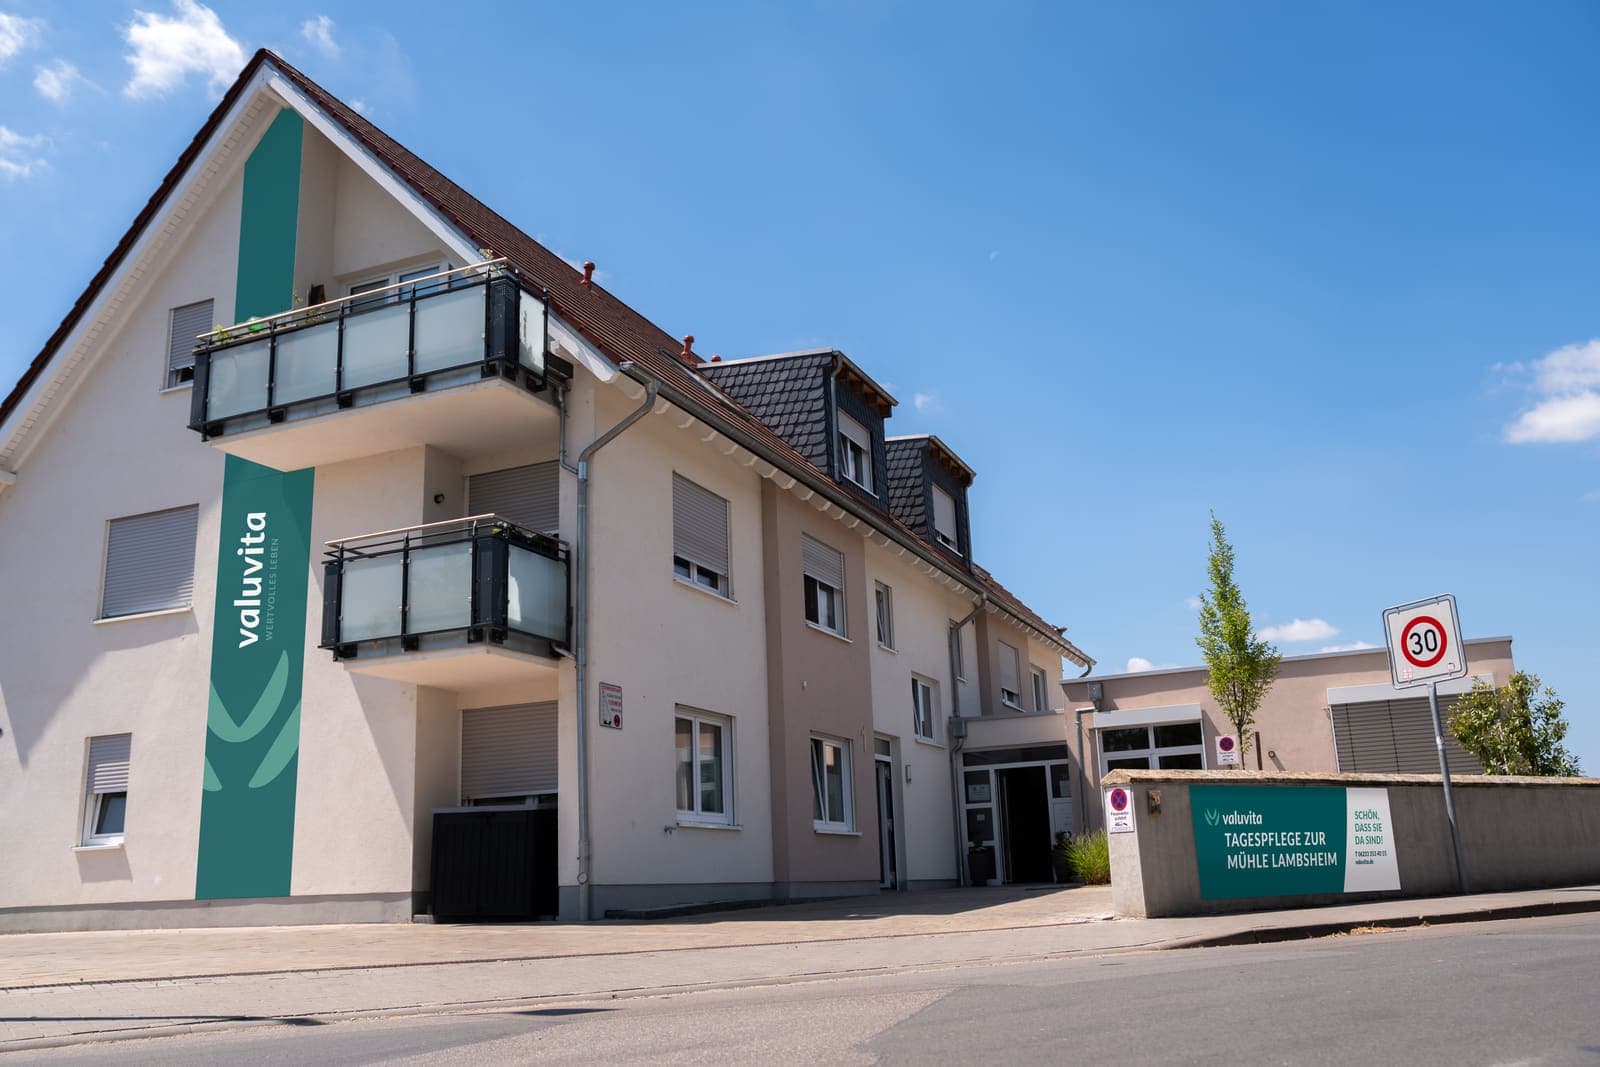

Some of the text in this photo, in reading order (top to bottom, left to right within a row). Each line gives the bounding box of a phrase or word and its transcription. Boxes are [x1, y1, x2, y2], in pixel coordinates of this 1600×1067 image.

[234, 511, 267, 649] valuvita
[265, 538, 280, 641] WERTVOLLES LEBEN
[1409, 628, 1438, 656] 30
[1222, 810, 1263, 825] valuvita
[1354, 809, 1380, 821] SCHÖN,
[1355, 823, 1383, 832] DASS SIE
[1224, 831, 1326, 847] TAGESPFLEGE ZUR
[1355, 835, 1365, 845] DA
[1227, 851, 1338, 869] MÜHLE LAMBSHEIM
